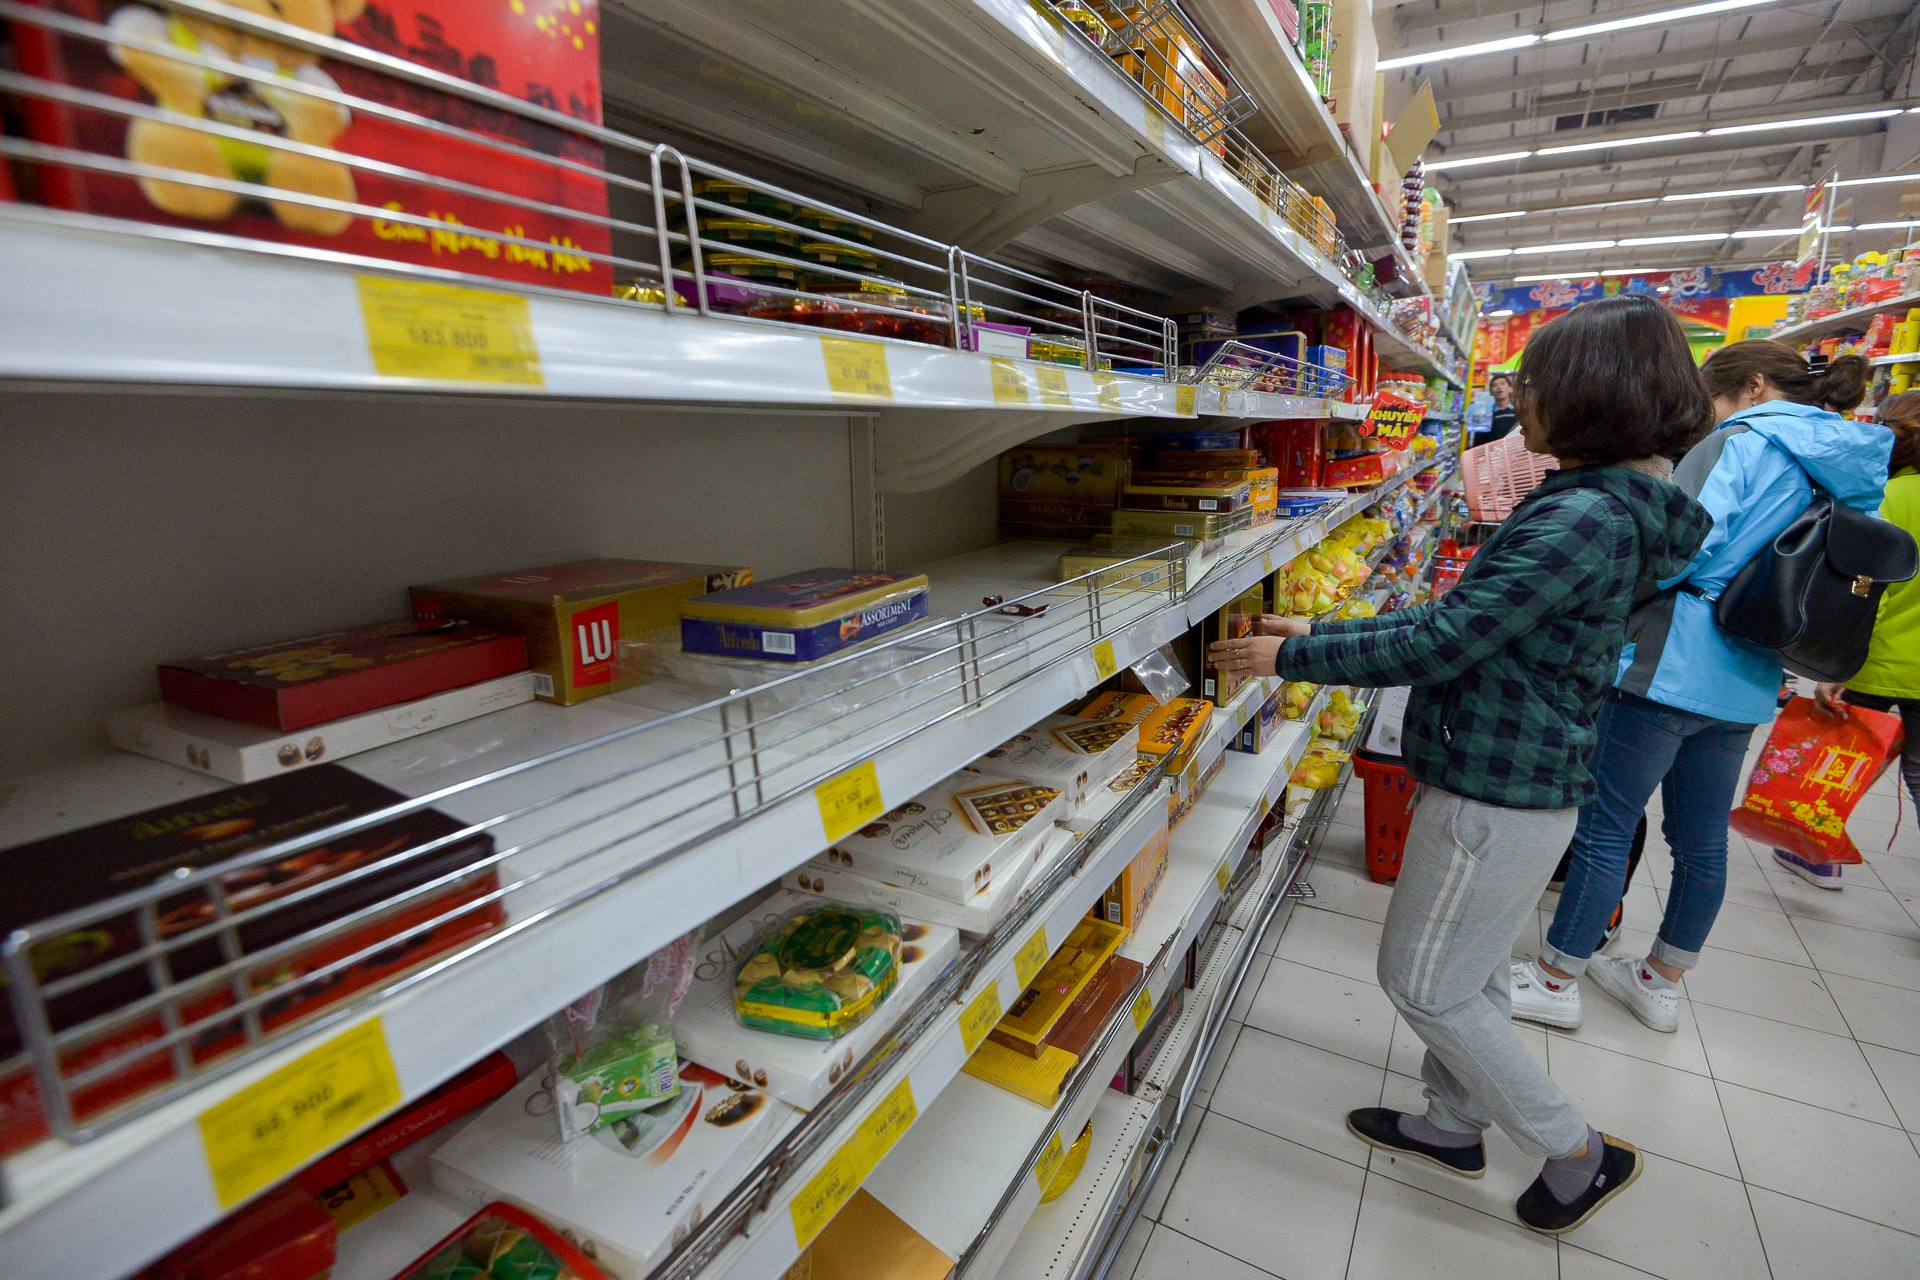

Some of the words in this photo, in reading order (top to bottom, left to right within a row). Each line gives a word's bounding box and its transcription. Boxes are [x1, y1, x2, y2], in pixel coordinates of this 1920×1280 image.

[1369, 408, 1423, 423] KHUYẾN
[860, 598, 912, 628] ASSORTMENT
[577, 619, 613, 665] LU
[891, 808, 952, 850] Amour
[400, 1105, 448, 1137] Chocolate
[874, 1105, 902, 1137] 146.600
[810, 1177, 842, 1215] 146.600
